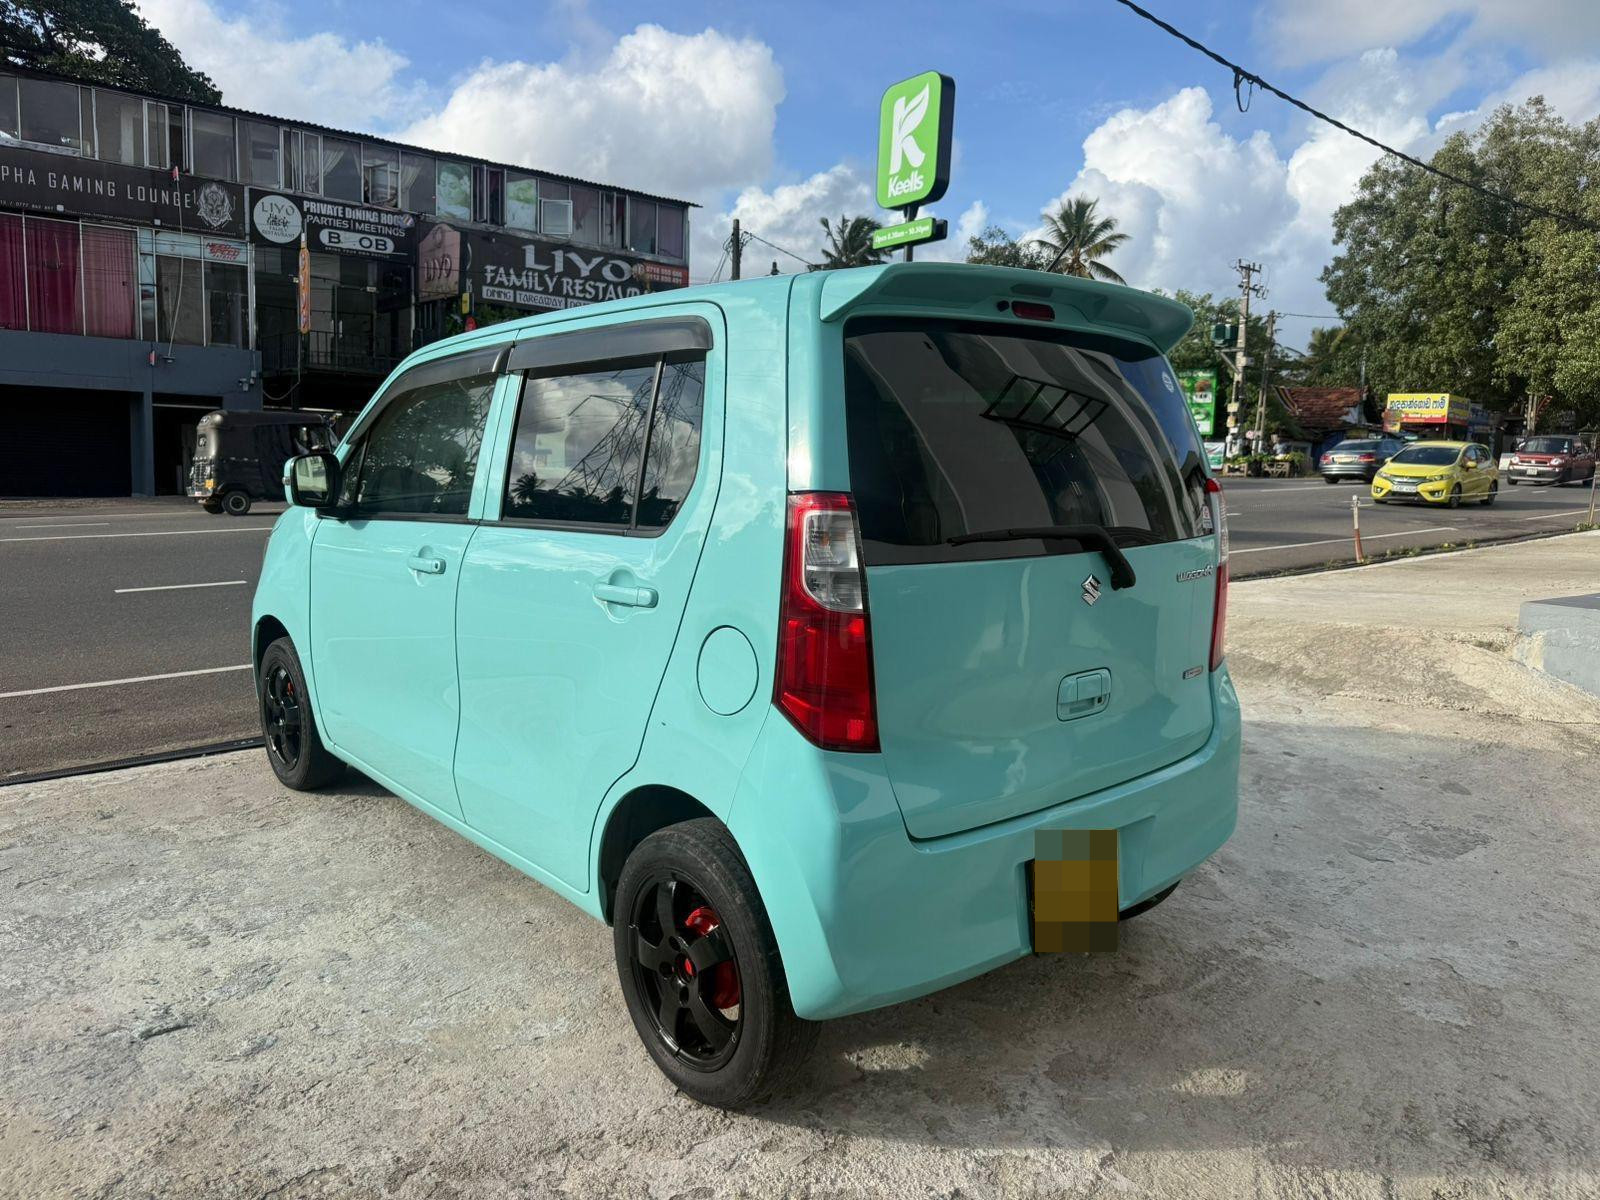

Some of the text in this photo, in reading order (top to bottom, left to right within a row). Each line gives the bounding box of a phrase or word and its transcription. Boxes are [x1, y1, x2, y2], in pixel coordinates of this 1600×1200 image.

[48, 172, 116, 197] GAMING
[127, 183, 191, 208] LOUNGE
[888, 170, 924, 198] Keells
[261, 201, 295, 216] LIYO
[303, 200, 344, 218] PRIVATE
[345, 207, 379, 223] DINING
[306, 214, 349, 229] PARTIES
[355, 223, 406, 237] MEETINGS
[522, 244, 633, 282] LIYO
[484, 264, 558, 293] FAMILY
[485, 288, 512, 300] DINING
